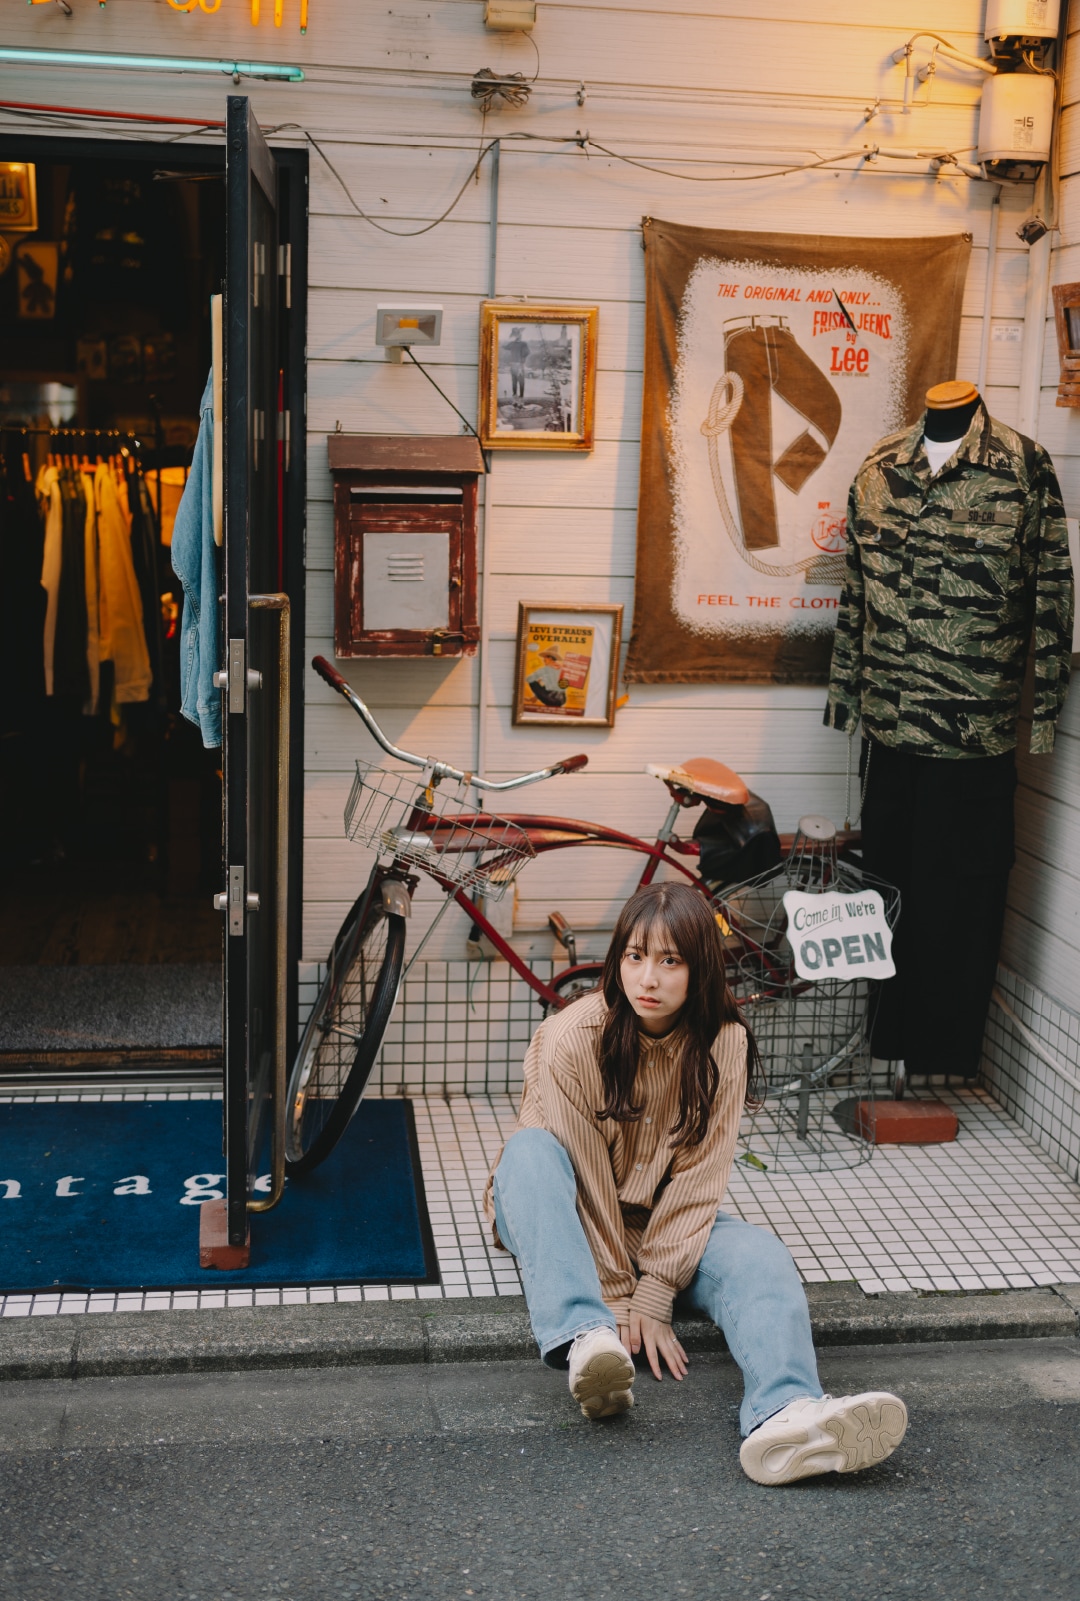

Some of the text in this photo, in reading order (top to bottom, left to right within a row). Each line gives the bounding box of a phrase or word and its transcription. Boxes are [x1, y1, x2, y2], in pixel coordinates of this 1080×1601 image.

[717, 283, 740, 298] THE
[743, 285, 801, 302] ORIGINAL
[805, 289, 833, 304] AND
[845, 331, 857, 346] by
[829, 346, 870, 373] Lee
[967, 510, 996, 523] SO-CAL
[697, 594, 739, 606] FEEL
[745, 596, 782, 608] THE
[530, 626, 593, 636] LEVI STRAUSS
[533, 634, 587, 644] OVERALLS
[793, 901, 877, 932] Come in We're
[800, 932, 888, 970] OPEN
